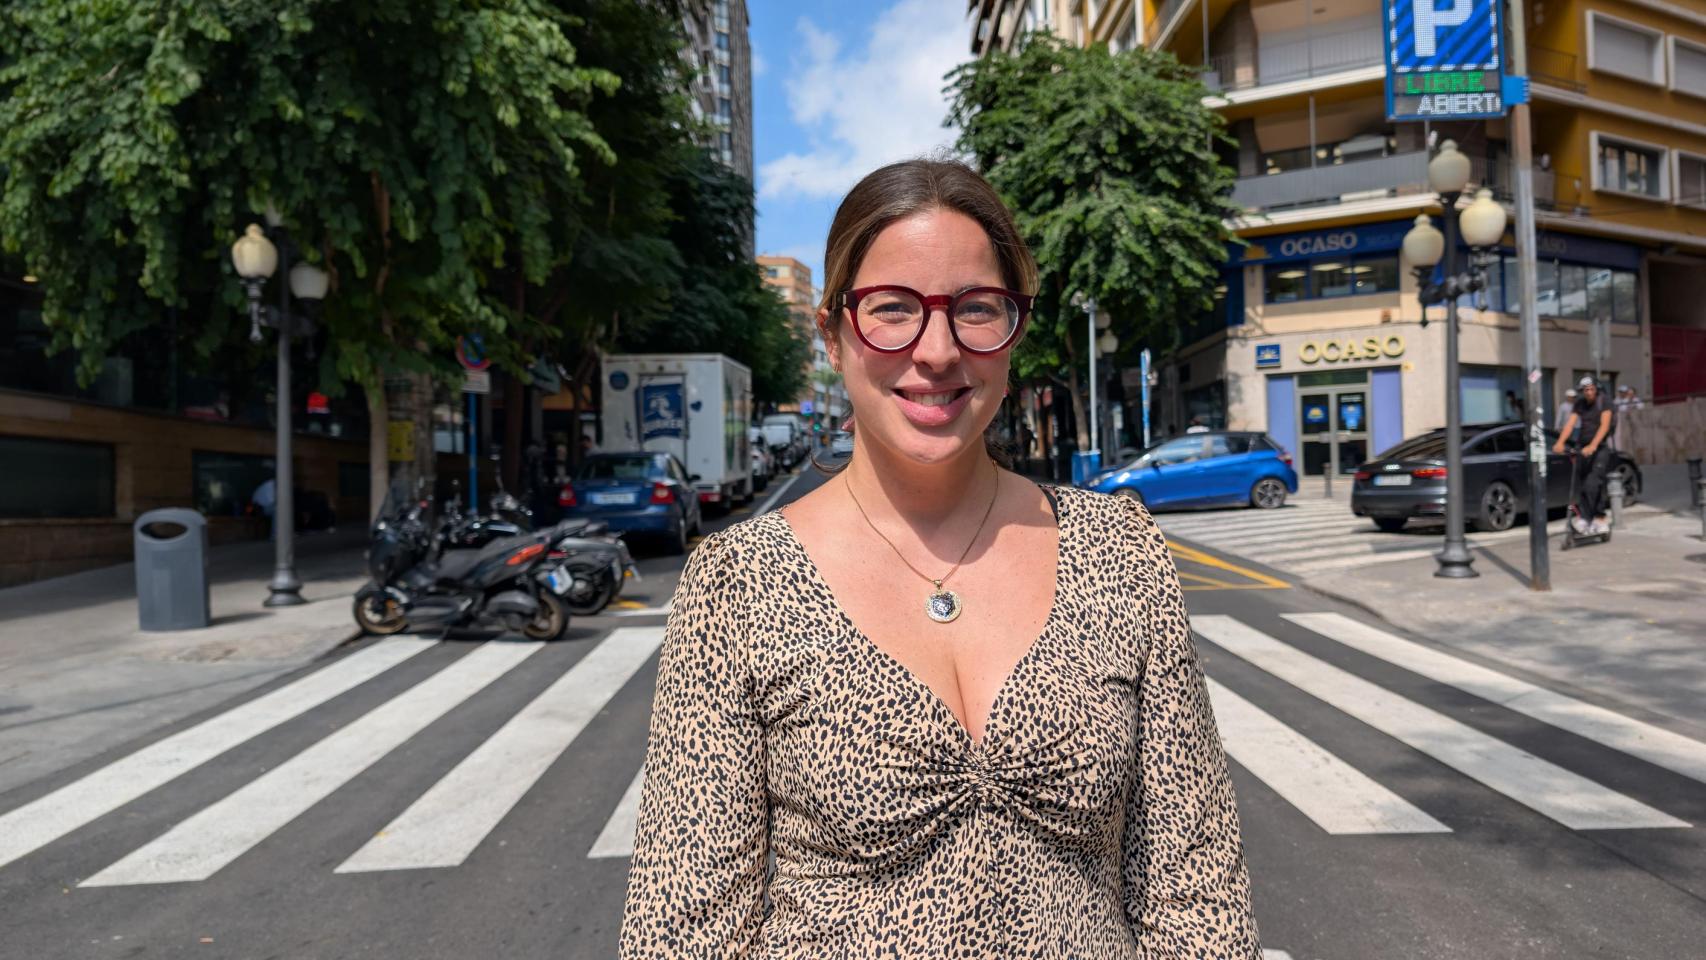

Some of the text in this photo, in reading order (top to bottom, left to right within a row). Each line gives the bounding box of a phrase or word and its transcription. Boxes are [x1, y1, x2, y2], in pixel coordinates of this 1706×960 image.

[1413, 0, 1473, 57] P
[1406, 71, 1486, 95] LIBRE
[1281, 231, 1358, 257] OCASO
[1299, 334, 1406, 365] OCASO
